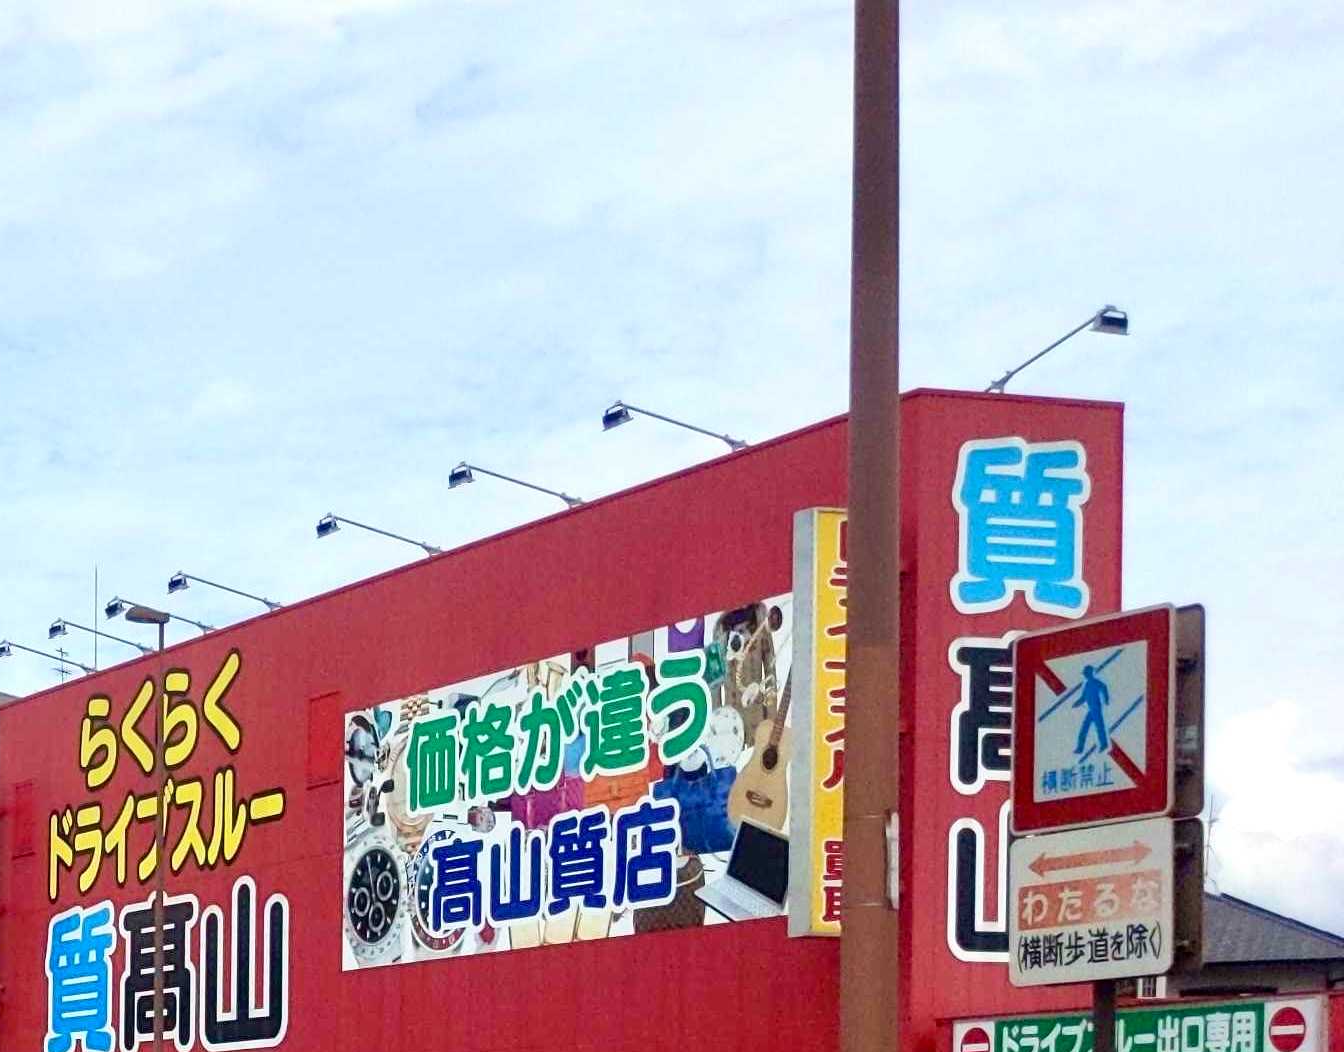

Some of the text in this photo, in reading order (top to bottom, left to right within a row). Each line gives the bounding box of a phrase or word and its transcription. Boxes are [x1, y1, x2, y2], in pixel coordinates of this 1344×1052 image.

[80, 652, 241, 789] らくらく
[406, 656, 712, 813] 価格が違う
[1042, 767, 1114, 794] 横断禁止
[49, 768, 285, 900] ドライブスルー
[1022, 879, 1162, 924] わたるな
